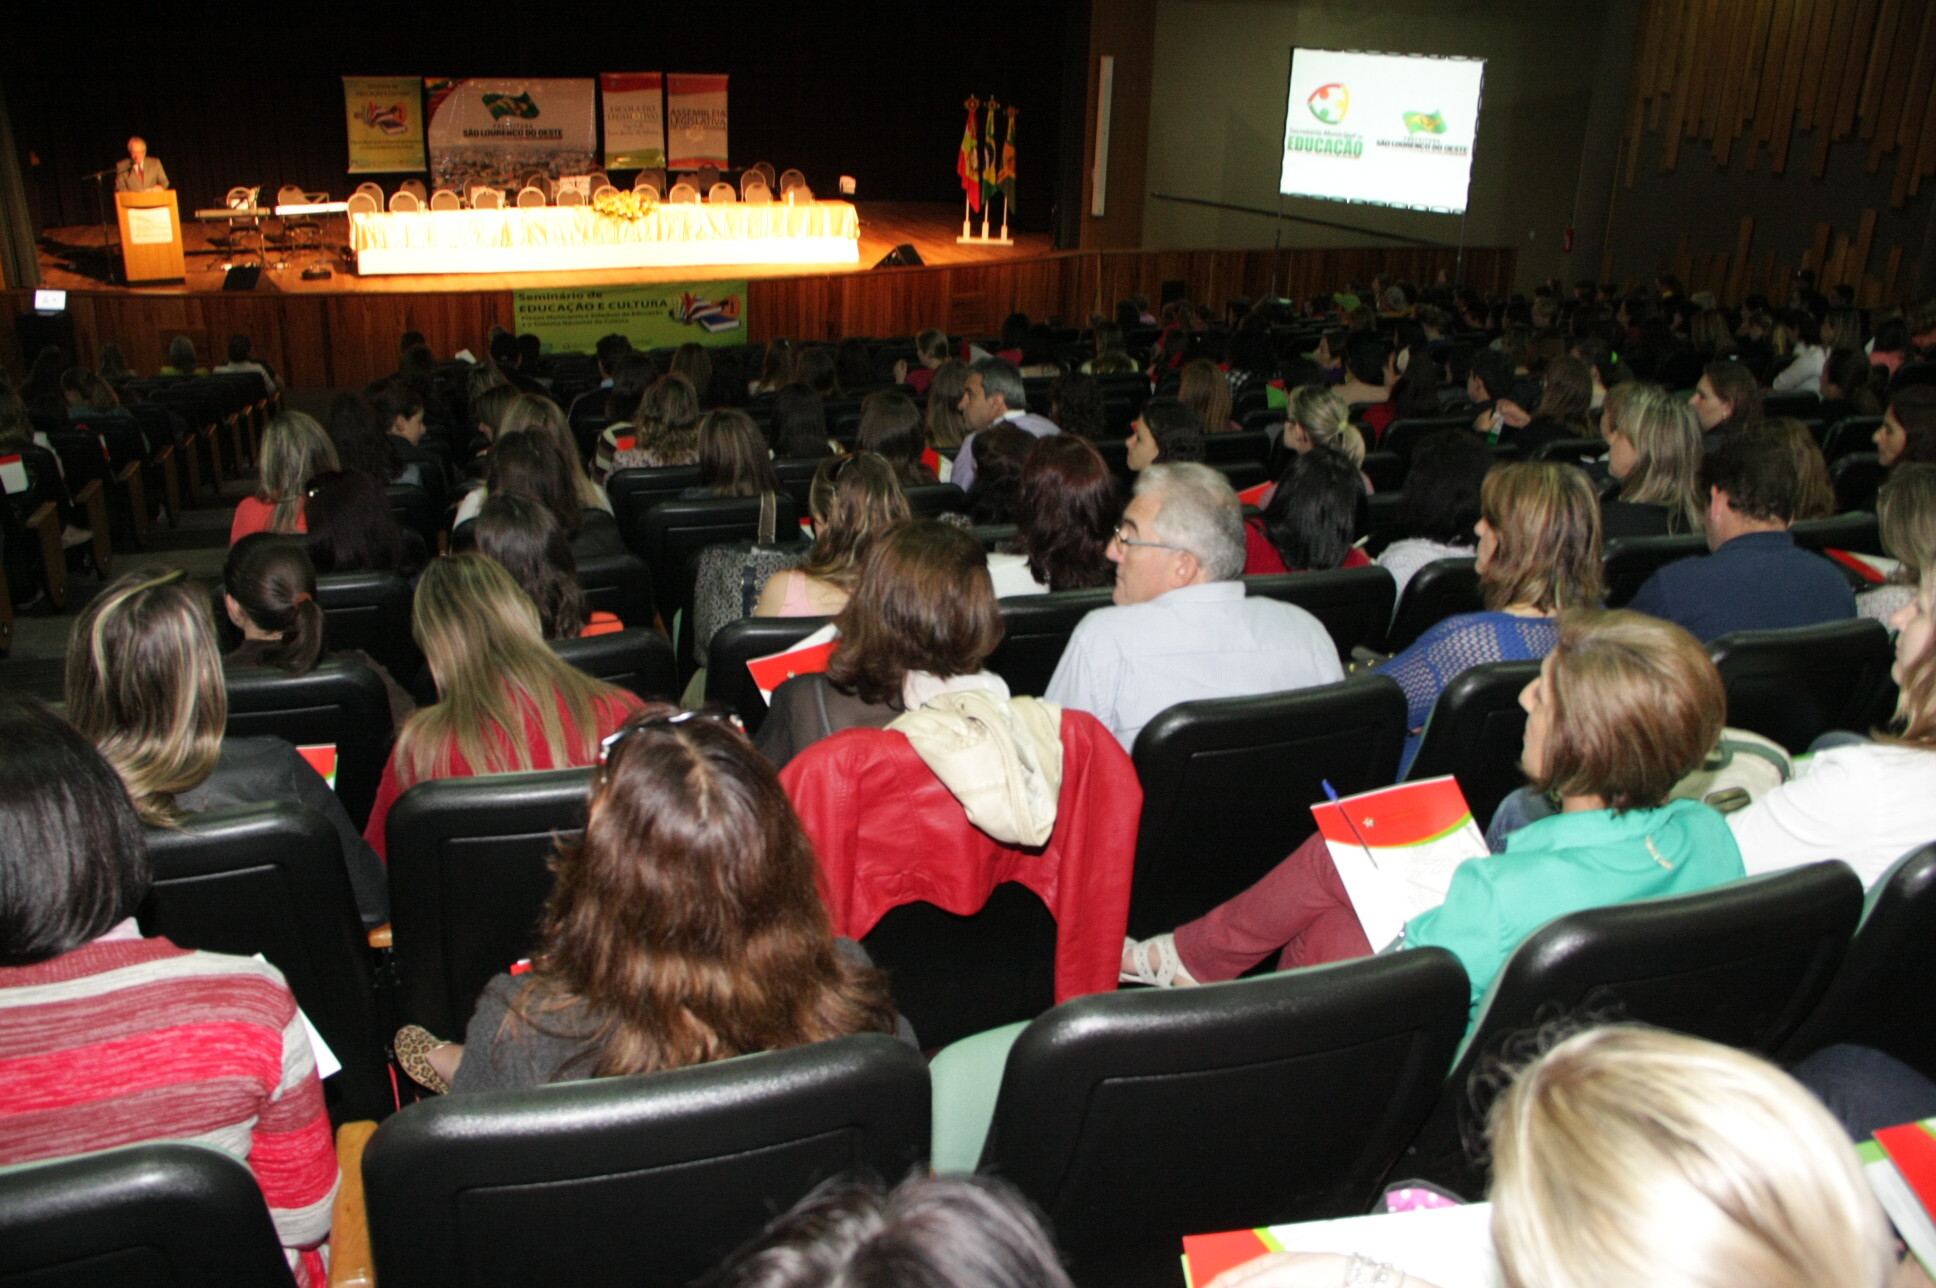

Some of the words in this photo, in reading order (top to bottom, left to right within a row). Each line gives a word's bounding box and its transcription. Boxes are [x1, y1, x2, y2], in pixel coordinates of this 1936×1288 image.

[463, 128, 479, 137] SÃO
[480, 129, 524, 138] LOURENÇO
[525, 129, 537, 138] DO
[538, 129, 563, 138] OESTE
[1287, 134, 1364, 157] EDUCAÇÃO
[1376, 139, 1390, 147] SÃO
[1391, 140, 1430, 151] LOURENÇO
[1444, 144, 1468, 154] OESTE
[518, 291, 584, 302] Seminário
[587, 290, 603, 300] de
[519, 301, 595, 313] EDUCAÇÃO
[598, 302, 605, 310] E
[608, 299, 667, 310] CULTURA
